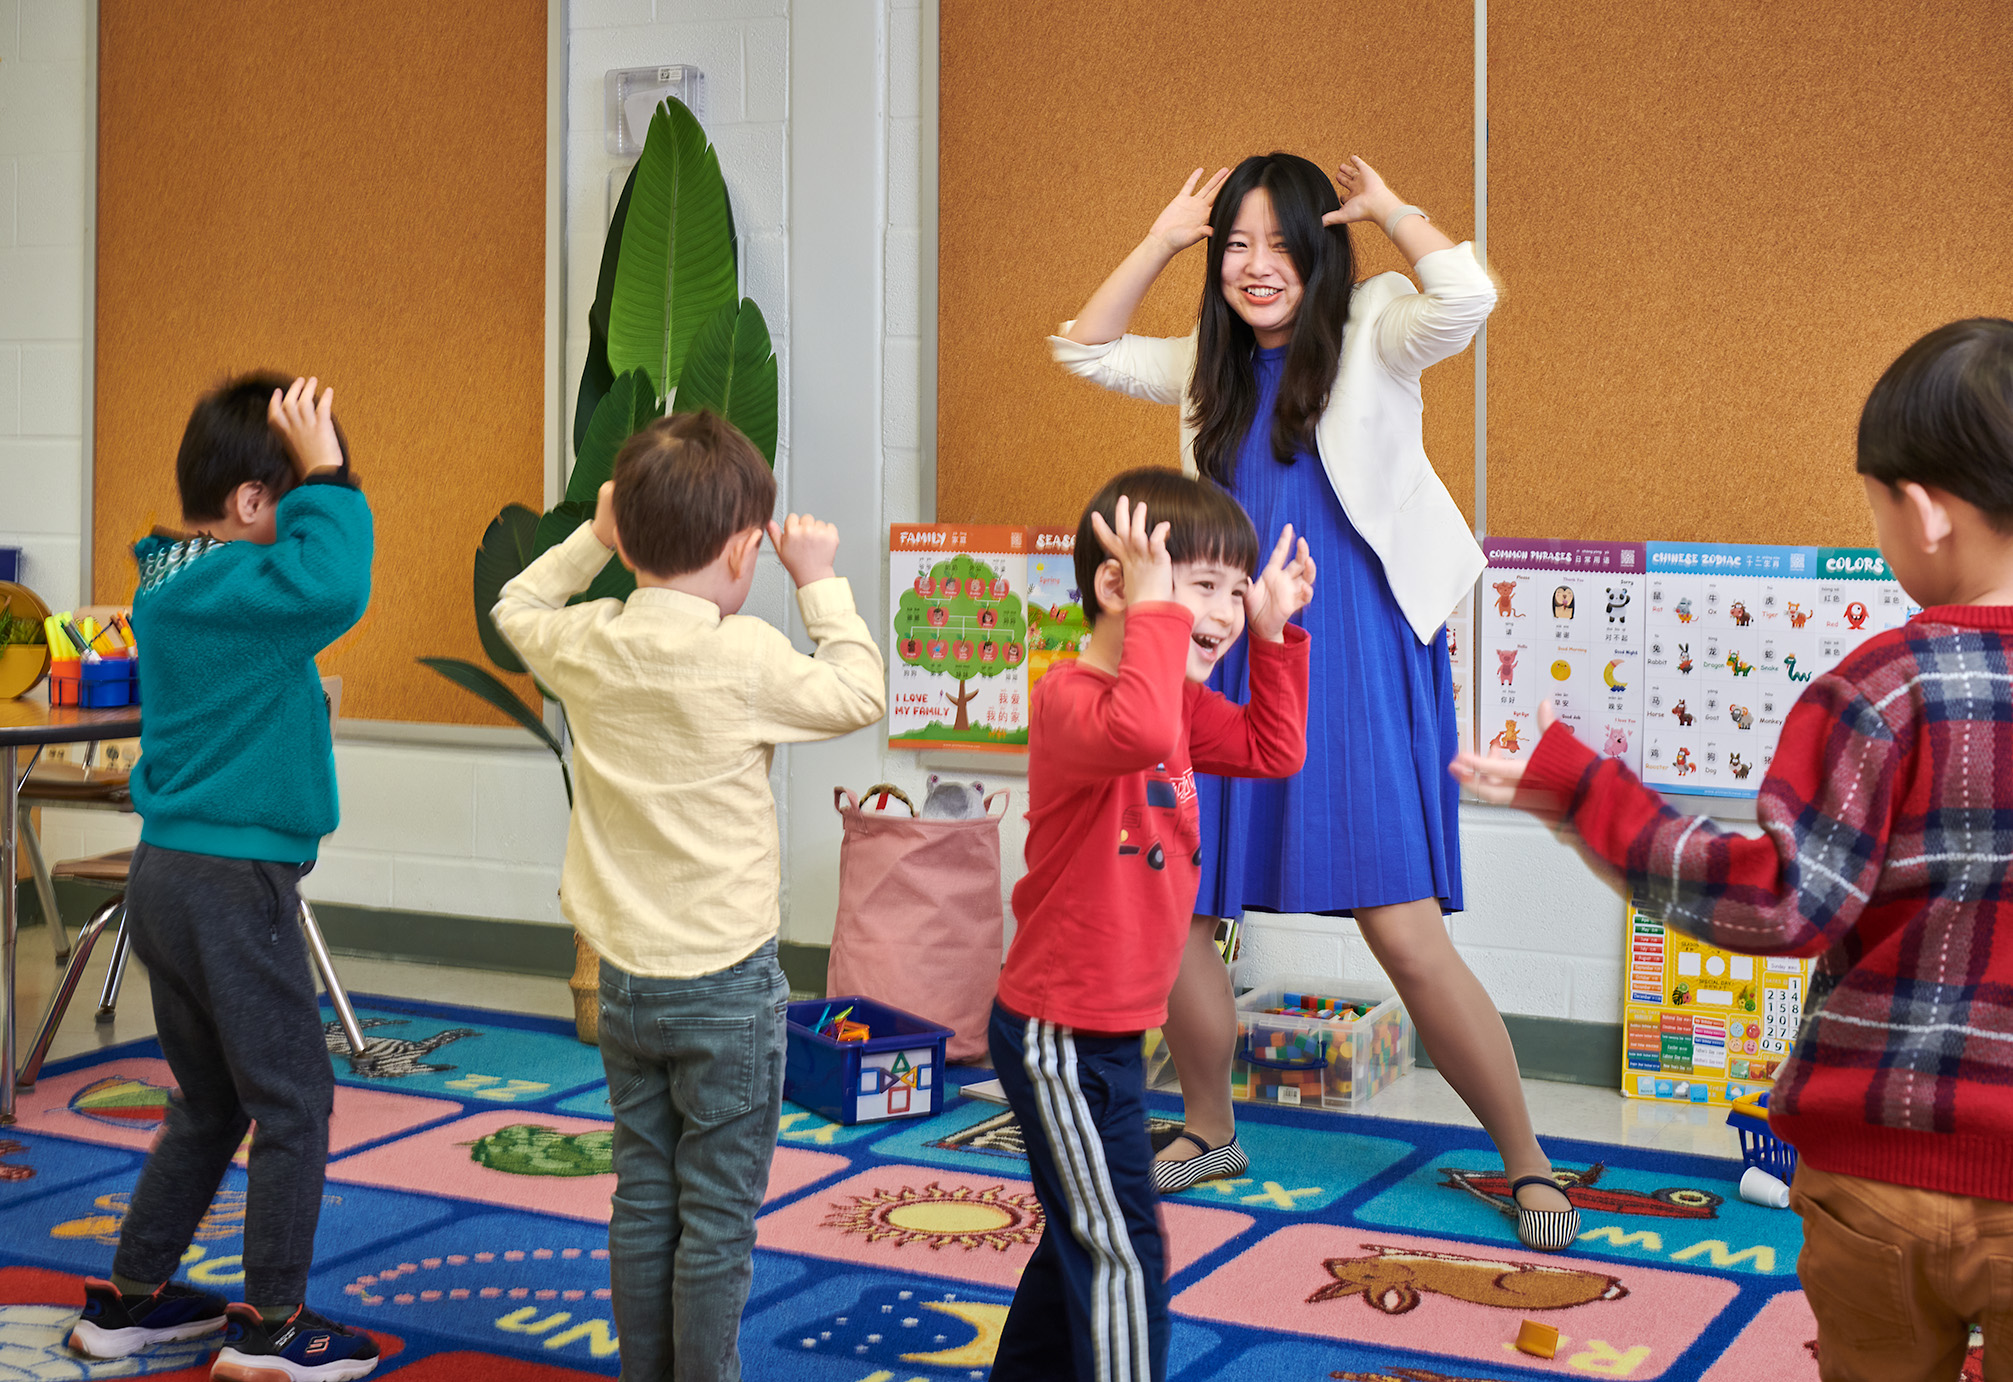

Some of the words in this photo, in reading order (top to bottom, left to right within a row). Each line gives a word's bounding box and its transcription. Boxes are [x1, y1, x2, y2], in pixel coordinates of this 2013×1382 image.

[900, 531, 946, 545] FAMILY
[1489, 549, 1528, 560] COMMON
[1530, 550, 1572, 562] PHRASES
[1652, 552, 1698, 565] CHINESE
[1701, 553, 1741, 566] ZODIAC
[1746, 559, 1780, 568] 十二生肖
[1826, 557, 1884, 573] COLORS
[1040, 576, 1060, 584] Spring
[1708, 594, 1717, 603] 牛
[1765, 596, 1774, 605] 虎
[1824, 595, 1840, 603] 红色
[1884, 596, 1899, 604] 蓝色
[1762, 610, 1778, 619] Tiger
[1605, 634, 1628, 642] 对不起
[1652, 644, 1661, 653] 兔
[1709, 647, 1717, 656] 龙
[1825, 648, 1840, 656] 黑色
[1764, 650, 1774, 659] 蛇
[1703, 661, 1725, 669] Dragon
[896, 693, 899, 703] I
[903, 693, 928, 703] LOVE
[1000, 693, 1020, 704] 我爱
[1501, 696, 1515, 704] 你好
[1652, 696, 1660, 705] 马
[1708, 699, 1717, 708] 羊
[895, 706, 911, 715] MY
[913, 706, 950, 716] FAMILY
[987, 710, 1020, 723] 我的家
[1759, 718, 1783, 726] Monkey
[1650, 749, 1659, 758] 鸡
[1707, 752, 1716, 761] 狗
[1705, 767, 1717, 775] Dog
[1793, 980, 1797, 989] 1
[1768, 990, 1774, 999] 2
[1780, 991, 1786, 1000] 3
[1791, 992, 1798, 1001] 4
[1769, 1003, 1773, 1011] 1
[1780, 1004, 1786, 1013] 5
[1792, 1004, 1799, 1014] 8
[1767, 1015, 1773, 1024] 9
[1779, 1016, 1786, 1025] 0
[1794, 1017, 1797, 1026] 1
[1767, 1027, 1774, 1036] 2
[1780, 1028, 1786, 1037] 7
[1792, 1029, 1798, 1038] 2
[1762, 1039, 1769, 1049] 0
[1775, 1042, 1782, 1051] 9
